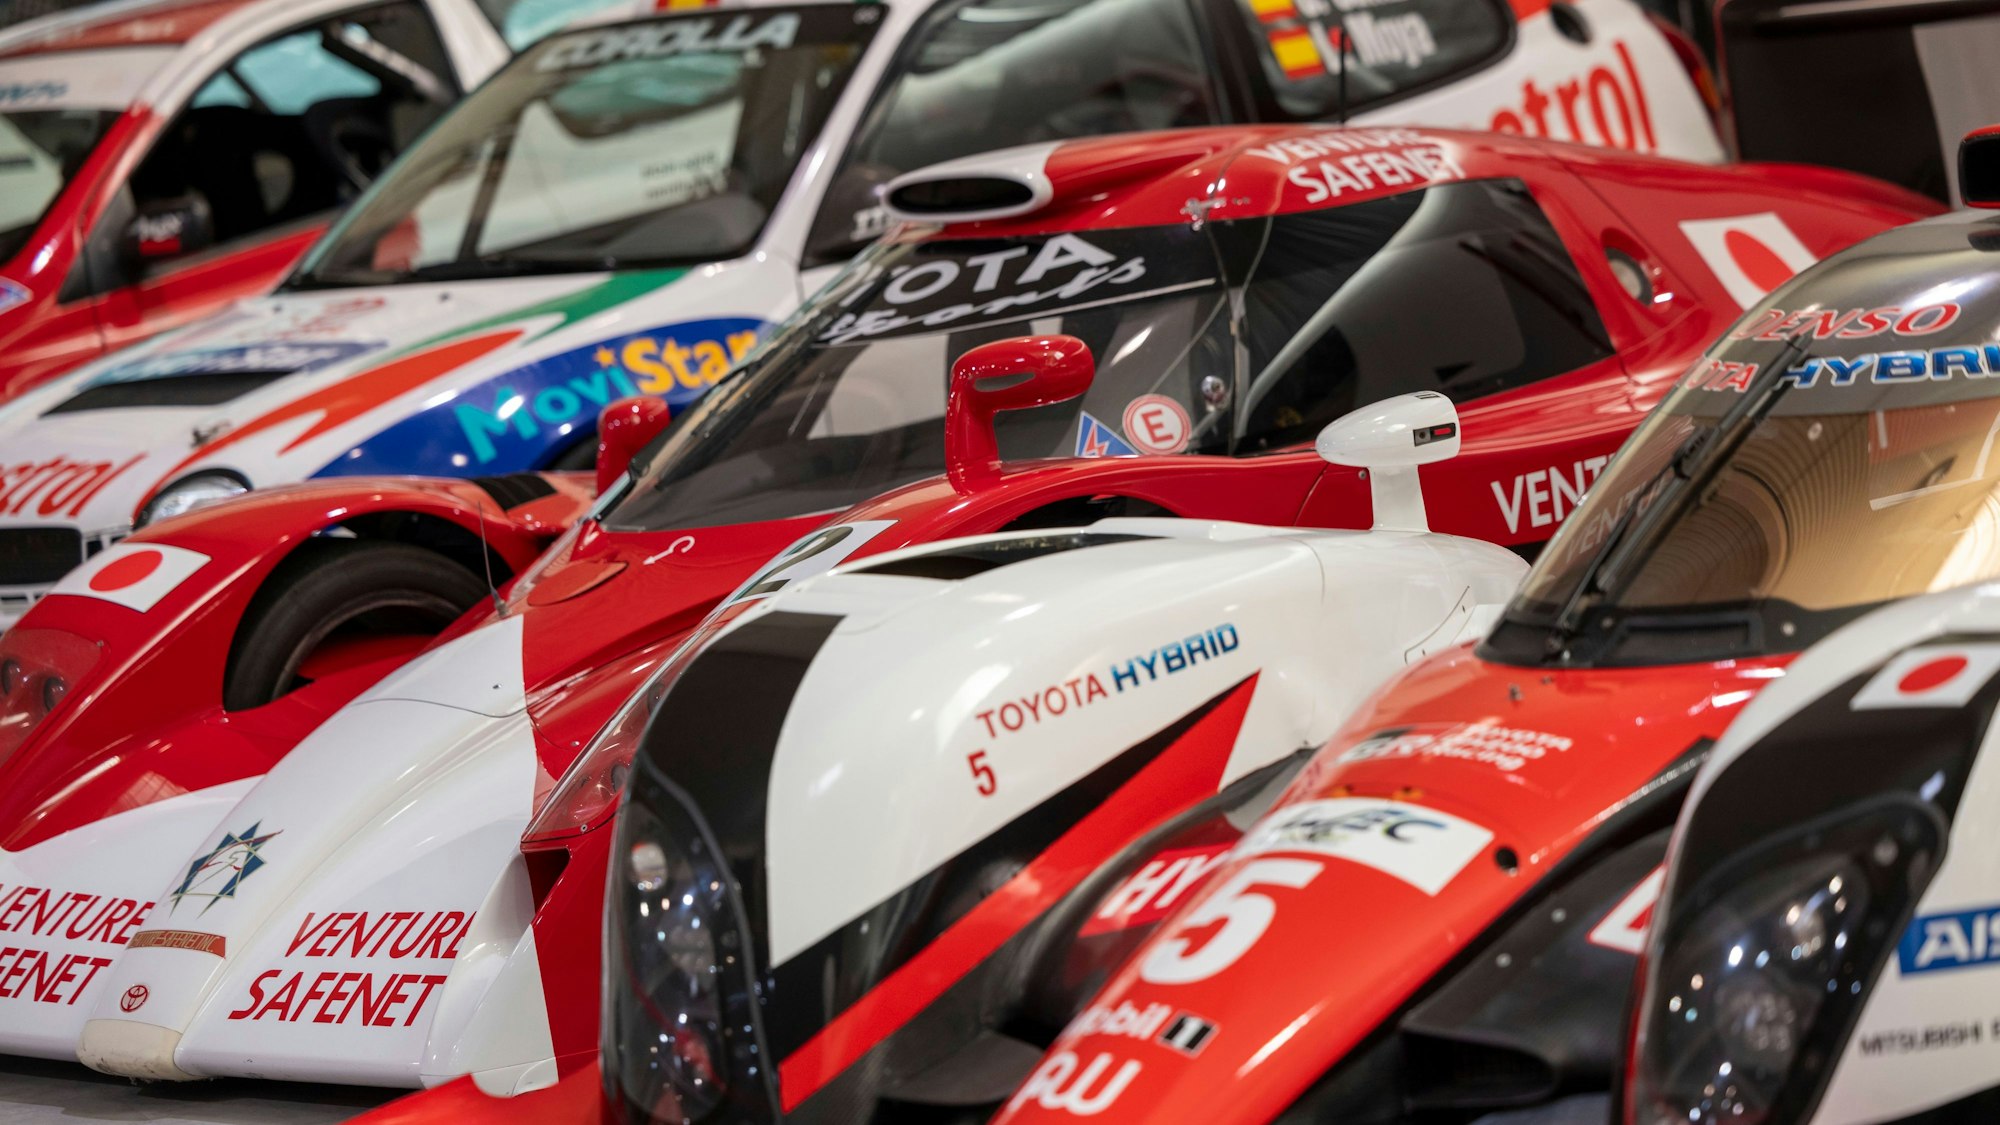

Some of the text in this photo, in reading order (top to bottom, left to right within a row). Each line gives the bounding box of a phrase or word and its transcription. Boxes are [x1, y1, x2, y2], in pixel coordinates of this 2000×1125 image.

[534, 13, 800, 72] COROLLA
[1287, 146, 1467, 204] SAFENET
[1728, 302, 1962, 342] DENSO
[1141, 408, 1174, 444] E
[1490, 452, 1620, 535] VENT
[976, 622, 1240, 739] TOYOTA HYBRID
[966, 749, 998, 797] 5
[1138, 858, 1326, 985] 5
[227, 969, 448, 1028] SAFENET
